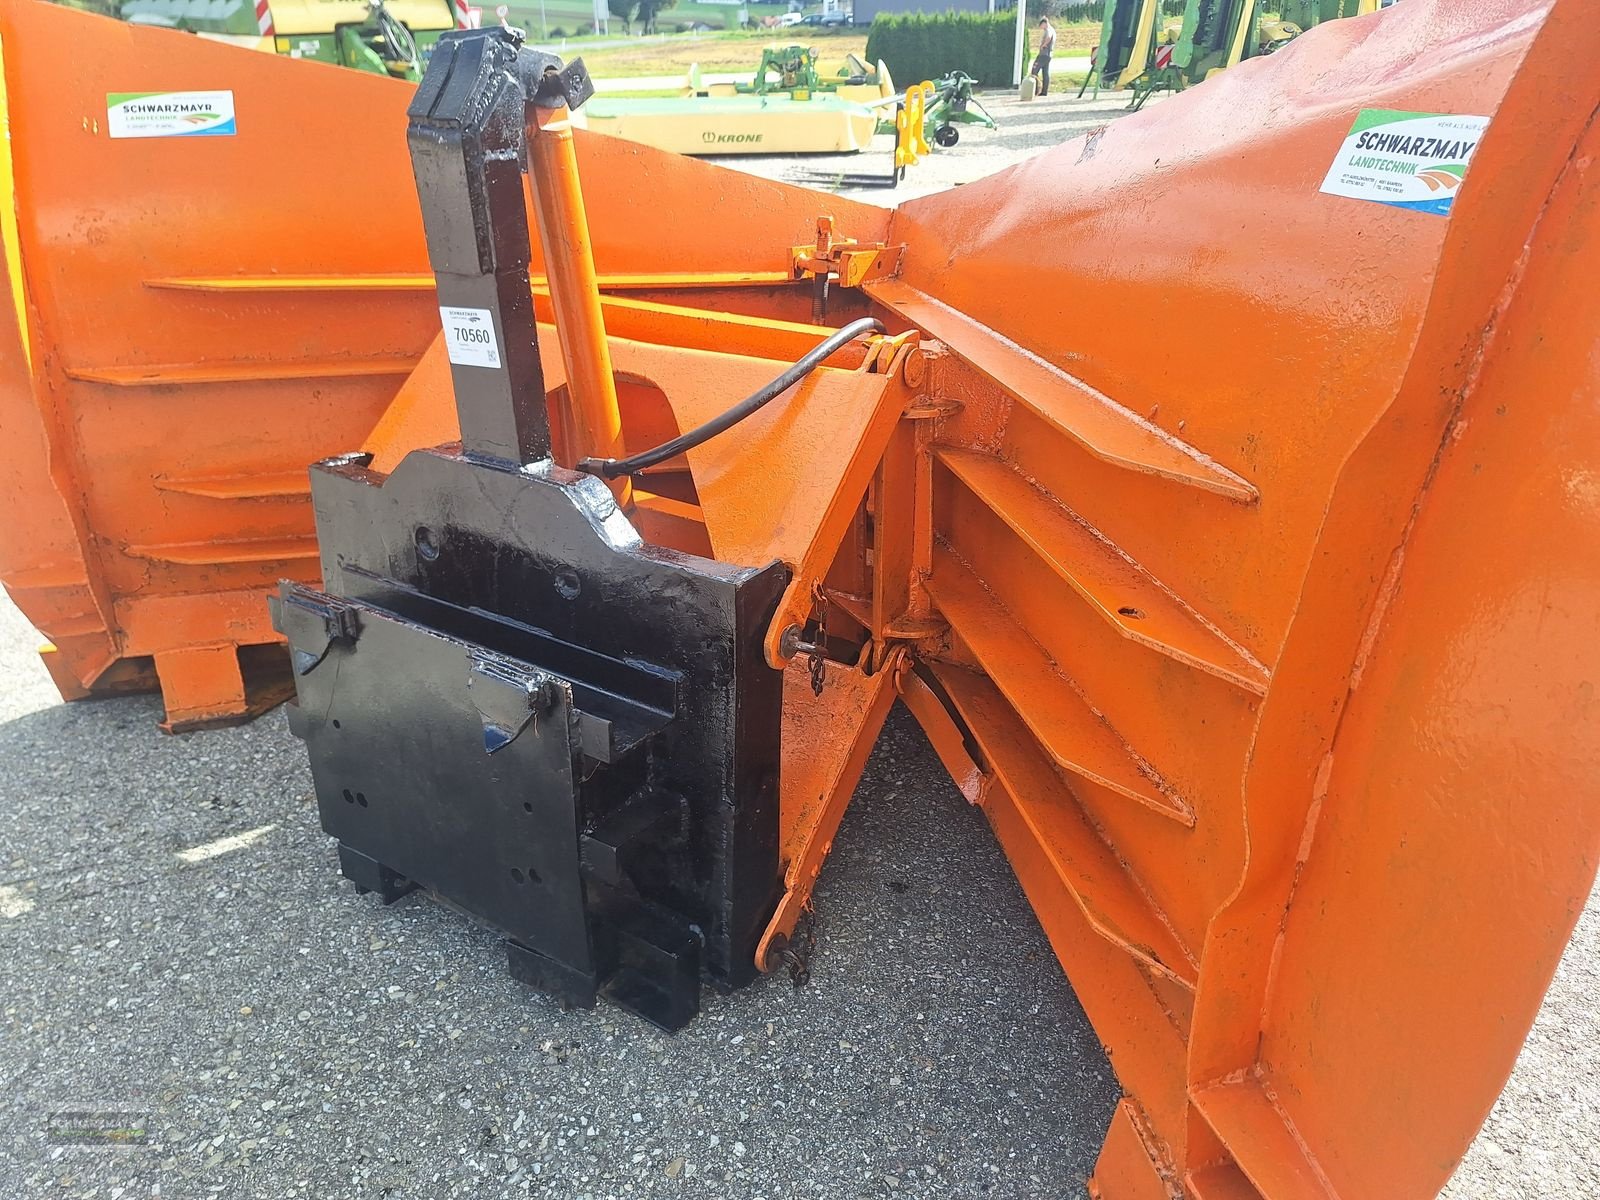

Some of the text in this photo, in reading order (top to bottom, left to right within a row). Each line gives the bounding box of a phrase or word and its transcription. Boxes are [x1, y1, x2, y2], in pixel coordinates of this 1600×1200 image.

[123, 104, 212, 113] SCHWARZMAYR
[717, 134, 764, 143] KRONE
[1348, 155, 1420, 176] LANDTECHNIK
[453, 327, 490, 344] 70560
